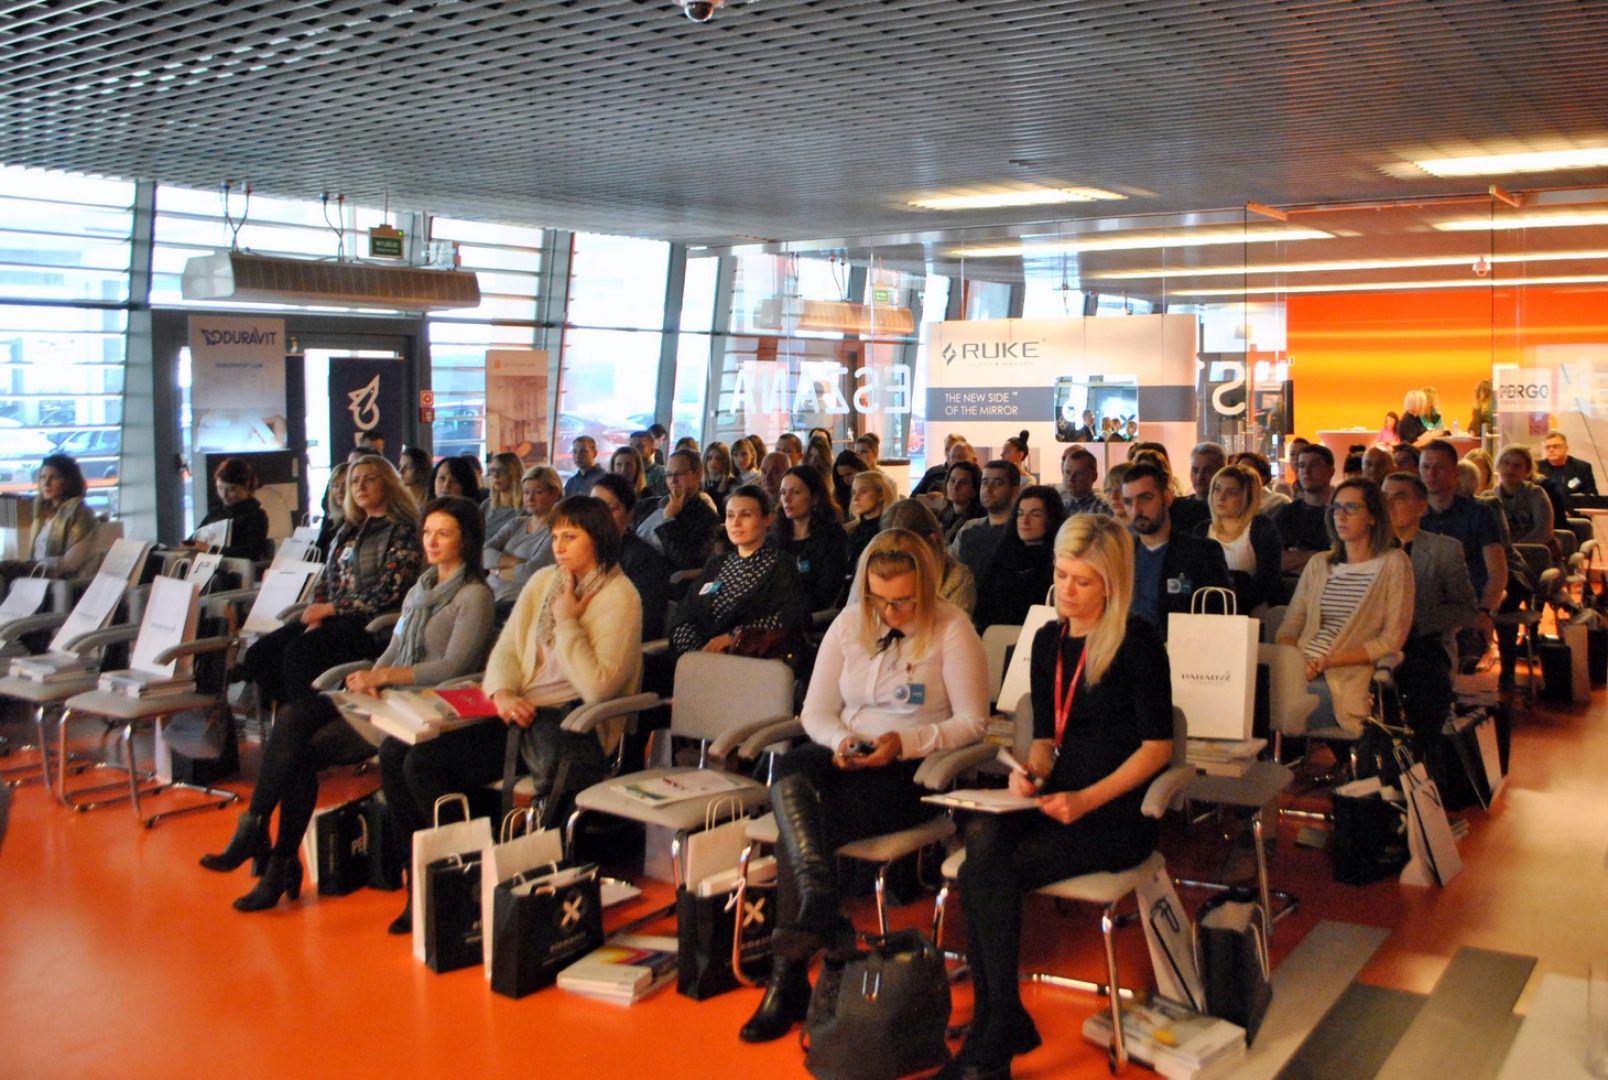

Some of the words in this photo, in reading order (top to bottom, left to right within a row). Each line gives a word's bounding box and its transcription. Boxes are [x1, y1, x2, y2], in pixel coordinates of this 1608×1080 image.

[223, 327, 277, 345] DURAVIT
[962, 342, 1040, 359] RUKE
[945, 393, 961, 403] THE
[963, 393, 986, 403] NEW
[988, 392, 1009, 403] SIDE
[945, 406, 959, 416] OF
[961, 406, 977, 416] THE
[979, 405, 1018, 416] MIRROR
